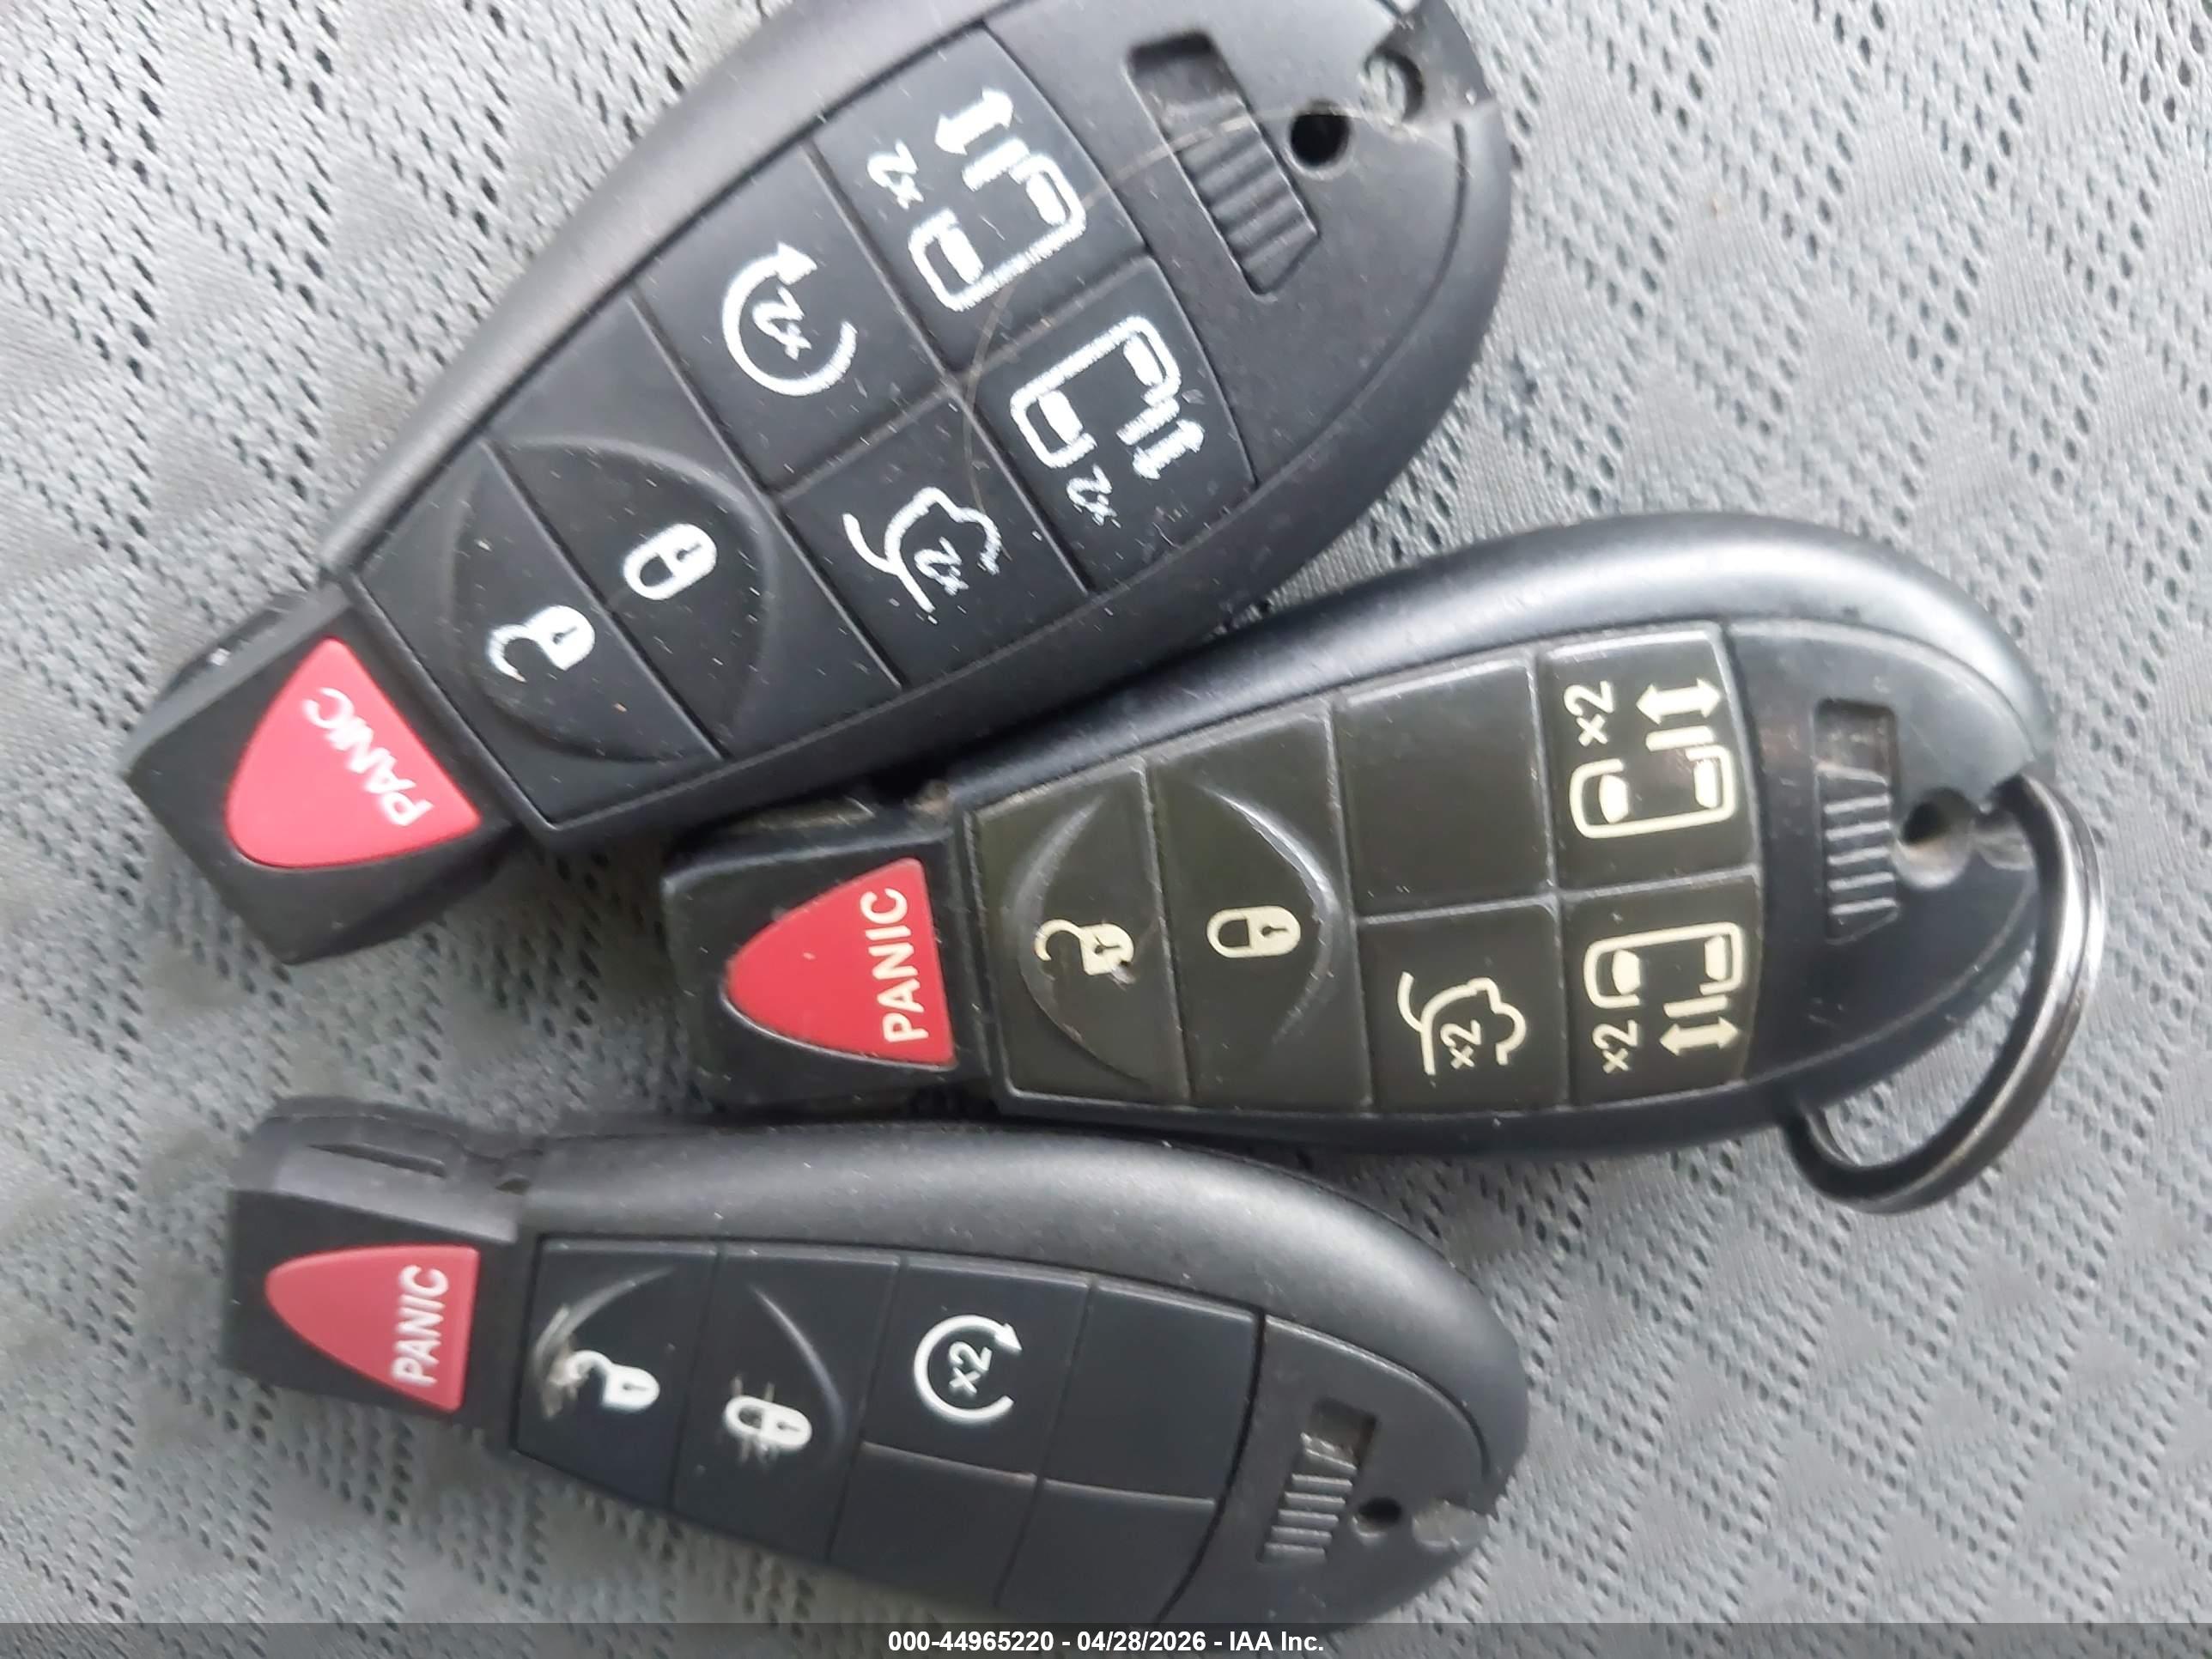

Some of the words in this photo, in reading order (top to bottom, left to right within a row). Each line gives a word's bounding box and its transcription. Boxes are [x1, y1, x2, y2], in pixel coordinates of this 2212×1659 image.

[1563, 680, 1614, 747] x2
[301, 687, 434, 826] PANIC
[860, 888, 929, 1042] PANIC
[1440, 1019, 1482, 1069] x2
[1592, 1019, 1639, 1074] x2
[392, 1264, 449, 1387] PANIC
[949, 1340, 991, 1395] x2
